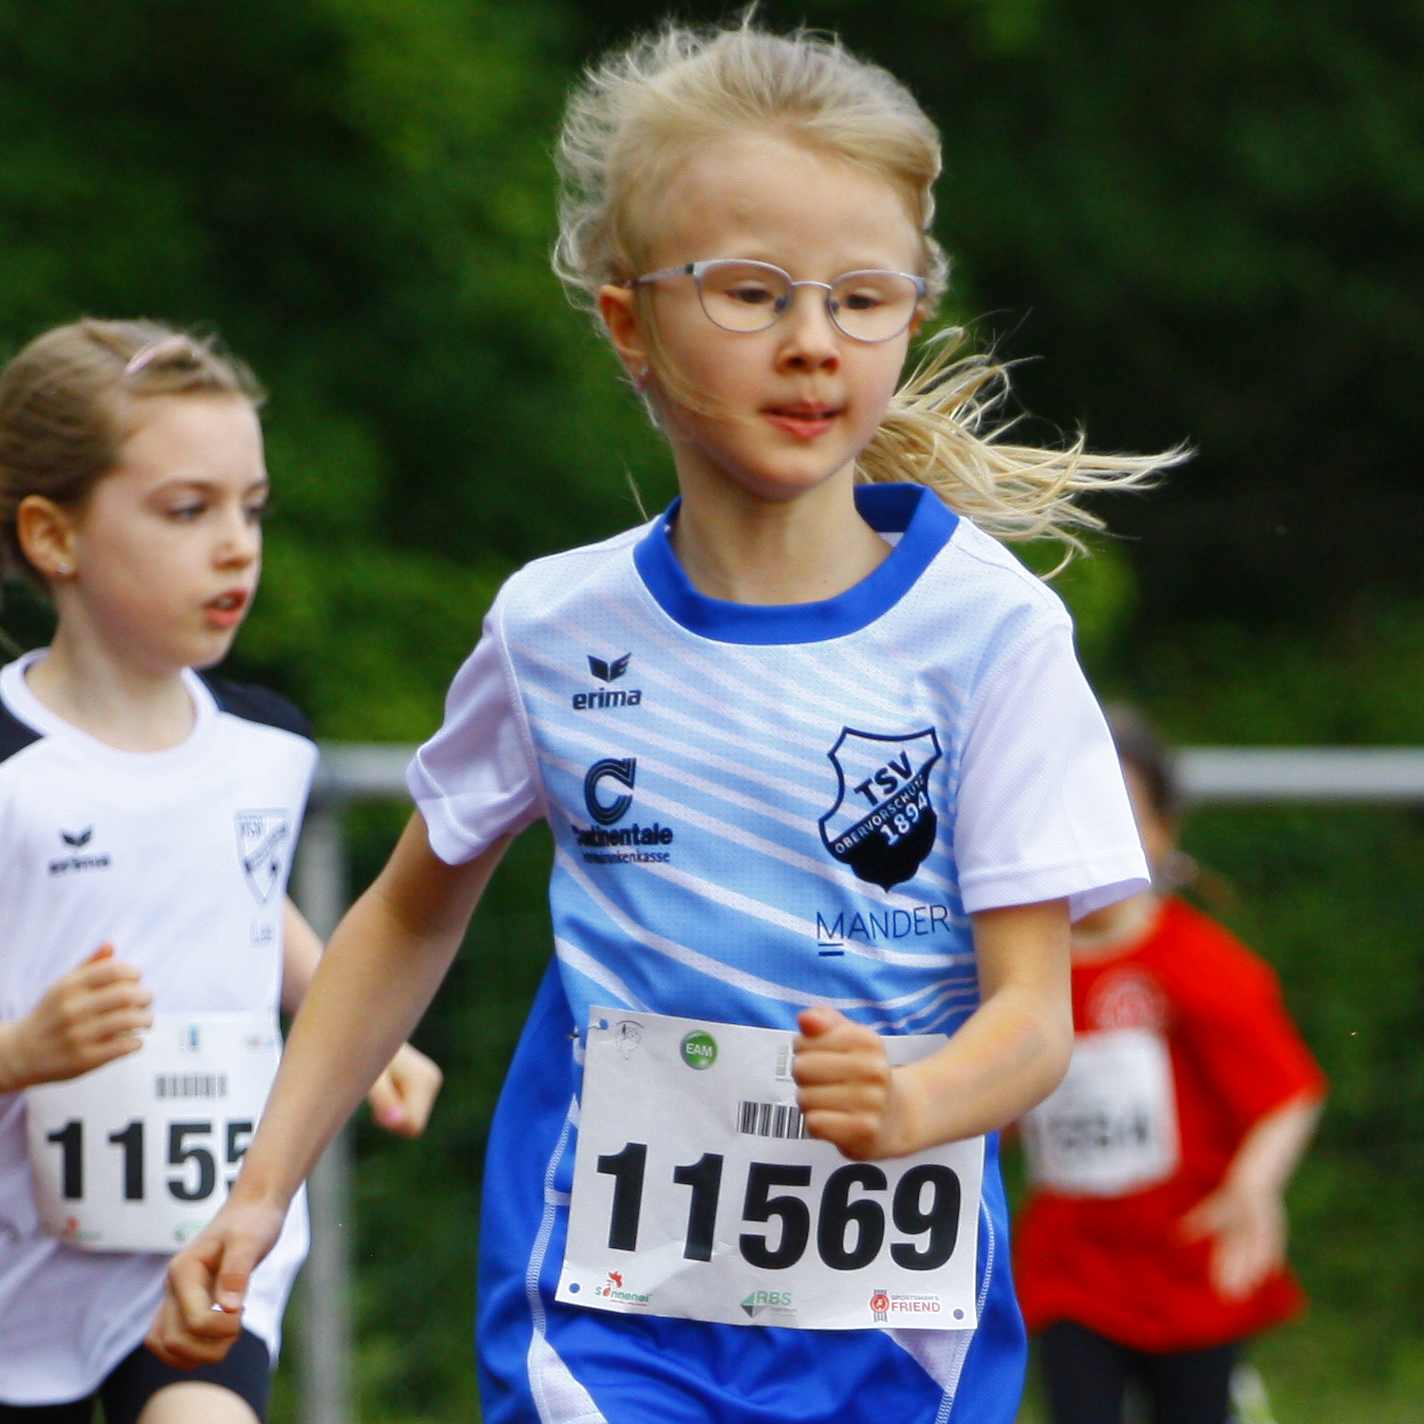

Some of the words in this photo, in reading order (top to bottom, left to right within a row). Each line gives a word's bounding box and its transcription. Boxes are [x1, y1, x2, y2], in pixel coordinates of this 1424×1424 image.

[572, 687, 642, 710] erima
[853, 750, 913, 807] TSV
[880, 791, 928, 846] 1894
[816, 904, 951, 941] MANDER
[686, 1042, 713, 1058] EAM
[47, 1119, 255, 1202] 1155
[596, 1142, 962, 1272] 11569
[891, 1301, 941, 1313] FRIEND
